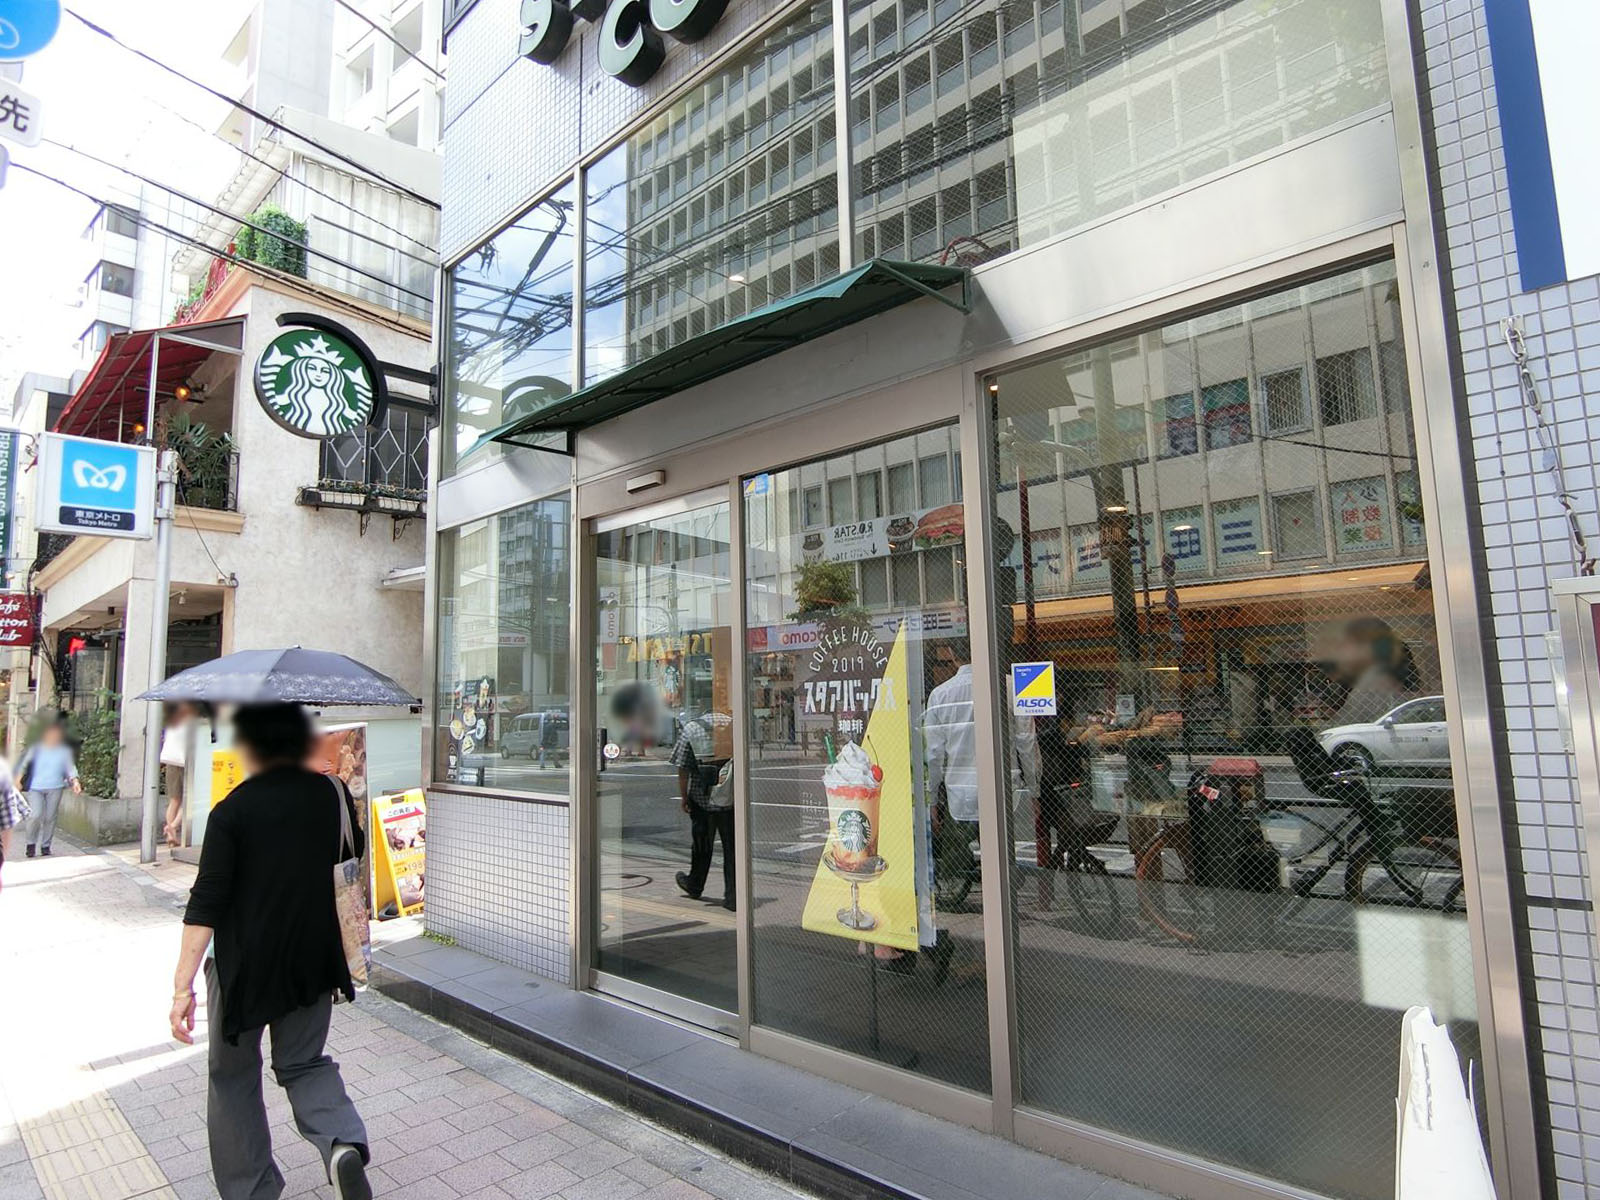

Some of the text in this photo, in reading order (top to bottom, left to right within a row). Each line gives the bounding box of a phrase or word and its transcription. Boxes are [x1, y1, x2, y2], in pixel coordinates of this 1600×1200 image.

[0, 94, 30, 133] 先
[75, 510, 121, 522] 東京メトロ
[77, 518, 118, 528] Tokyo Metro
[809, 625, 848, 672] COFFEE
[851, 625, 889, 669] HOUSE
[832, 656, 864, 673] 2019
[804, 677, 897, 713] スタアバックス
[1016, 697, 1054, 708] ALSOK
